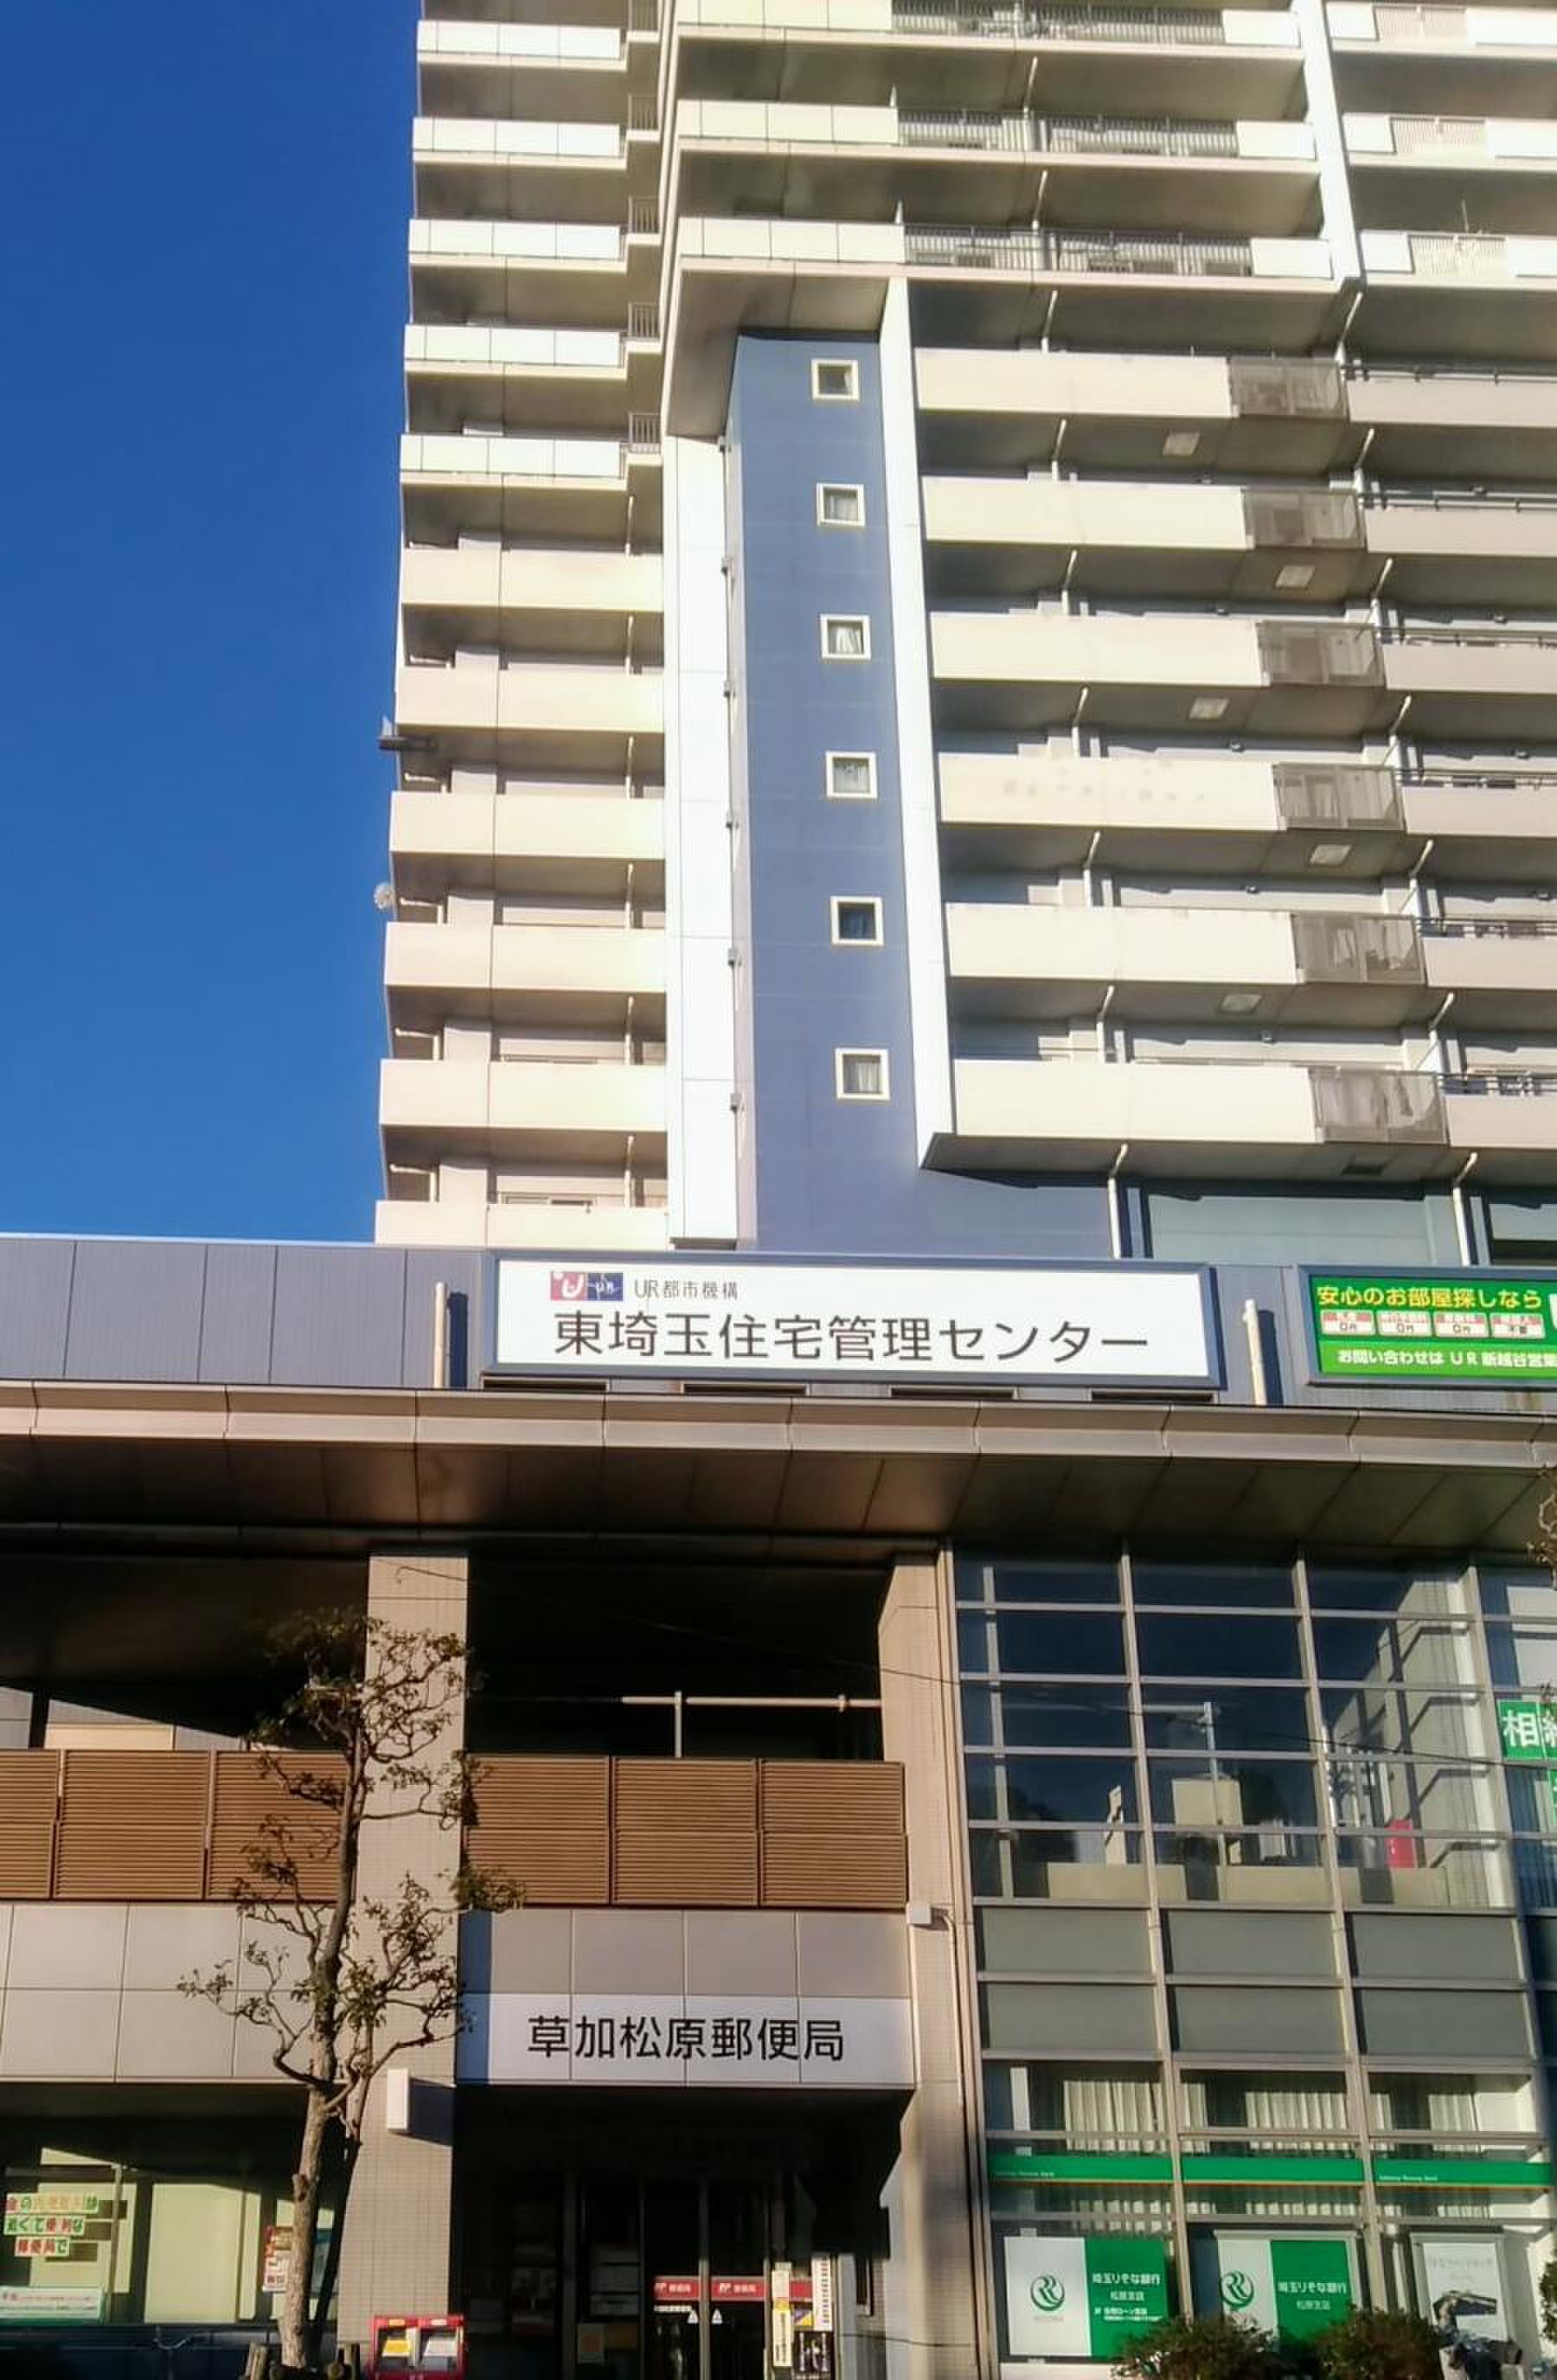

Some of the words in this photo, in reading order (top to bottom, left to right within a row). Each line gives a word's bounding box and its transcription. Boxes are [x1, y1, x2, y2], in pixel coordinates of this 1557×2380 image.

[634, 1279, 738, 1300] UR都市機構
[1317, 1285, 1542, 1308] 安心のお部屋探しなら
[553, 1309, 1149, 1363] 東埼玉住宅管理センター
[528, 2014, 844, 2062] 草加松原郵便局
